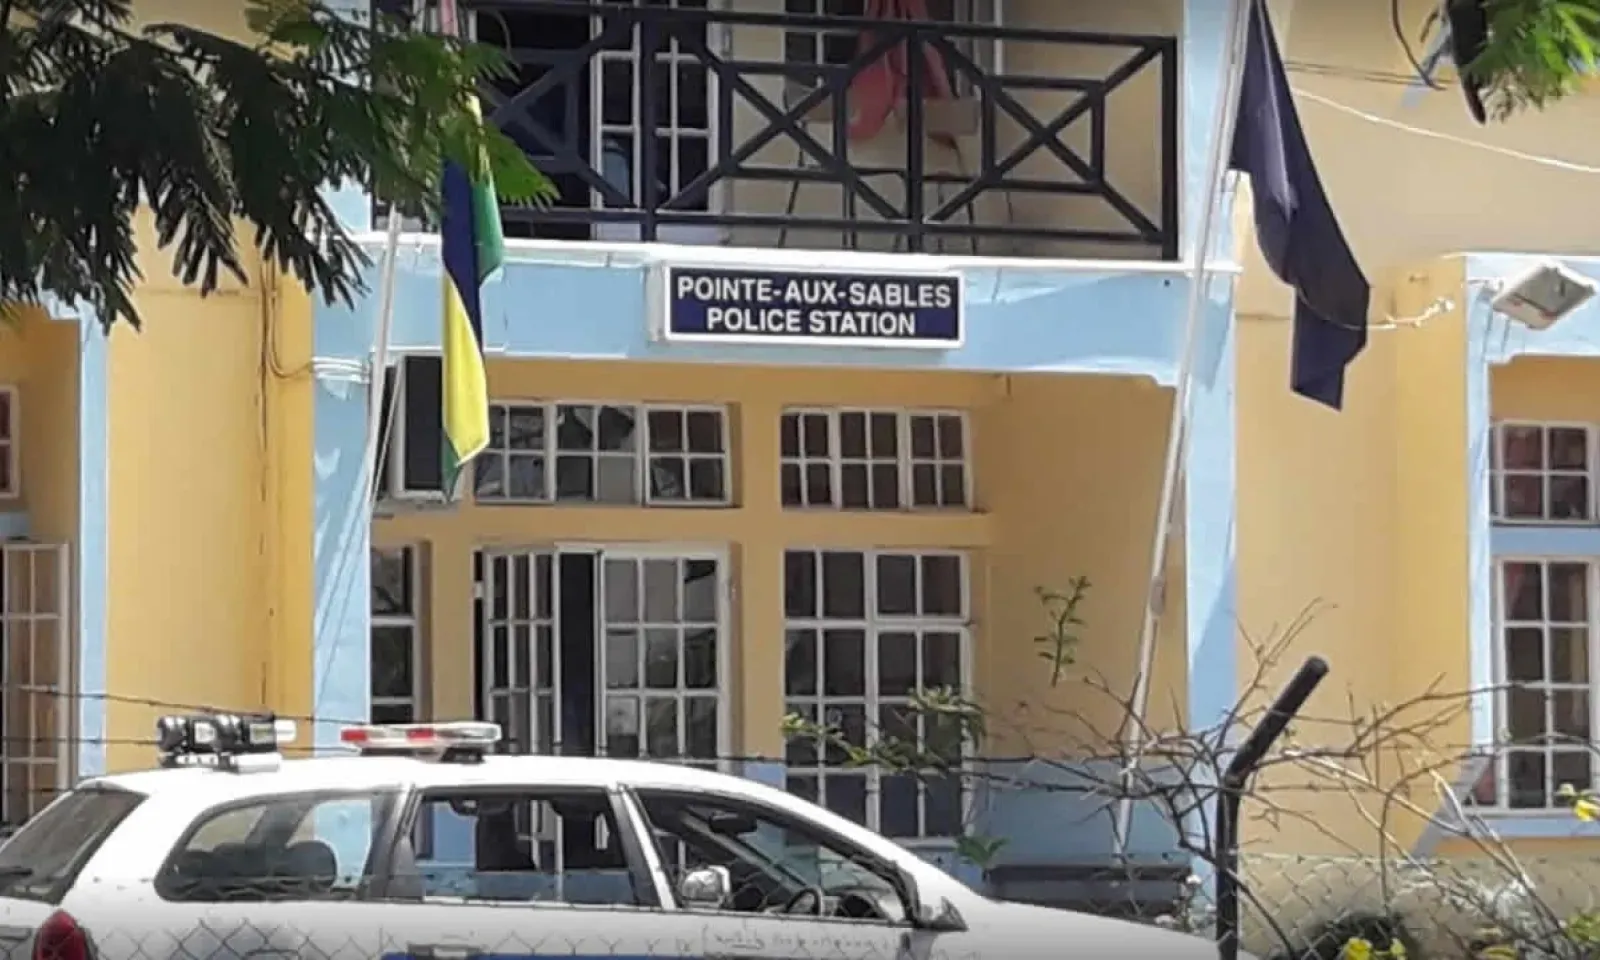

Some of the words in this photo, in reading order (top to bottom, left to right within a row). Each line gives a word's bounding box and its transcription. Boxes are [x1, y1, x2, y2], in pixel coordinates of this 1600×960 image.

[677, 276, 951, 308] POINTE-AUX-SABLES
[707, 307, 801, 332] POLICE
[809, 310, 915, 335] STATION
